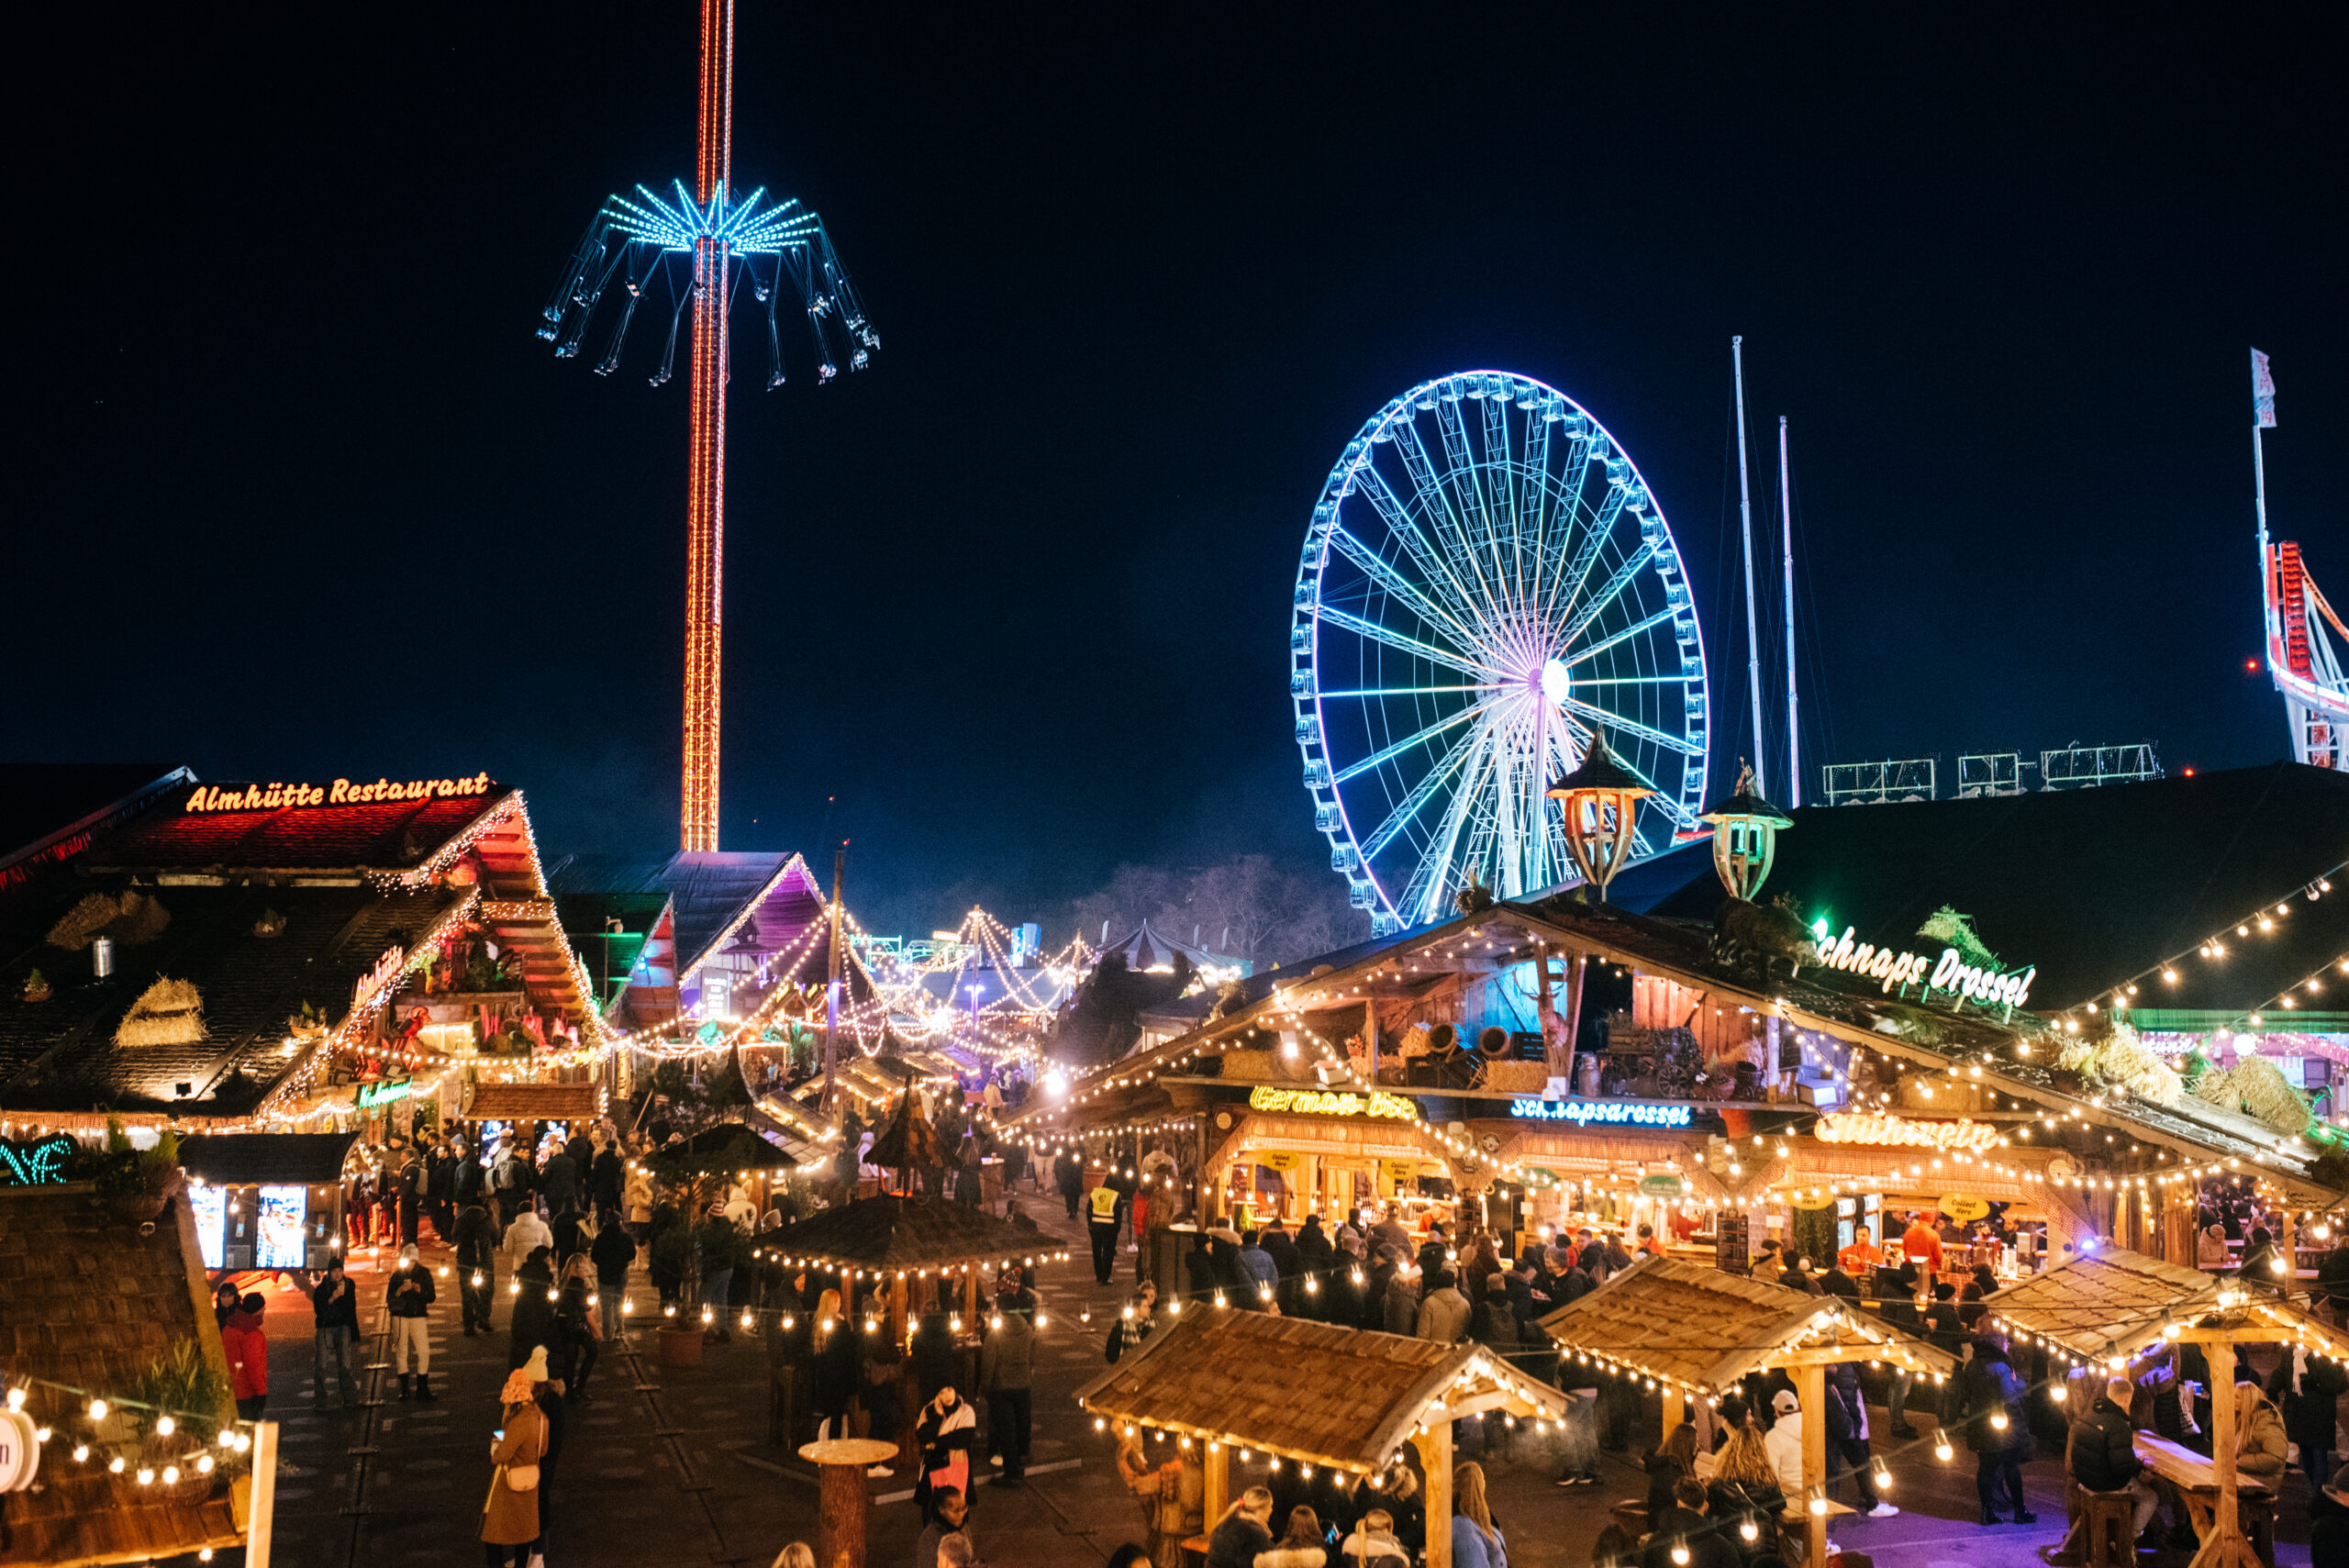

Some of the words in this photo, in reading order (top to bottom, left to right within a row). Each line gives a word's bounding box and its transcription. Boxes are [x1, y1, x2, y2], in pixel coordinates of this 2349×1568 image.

[185, 782, 324, 812] Almhütte
[329, 771, 488, 803] Restaurant
[1930, 948, 2036, 1007] Drossel
[1250, 1086, 1358, 1116] German
[1366, 1091, 1418, 1119] Bee
[1952, 1198, 1976, 1208] Collect
[1955, 1207, 1972, 1216] Here
